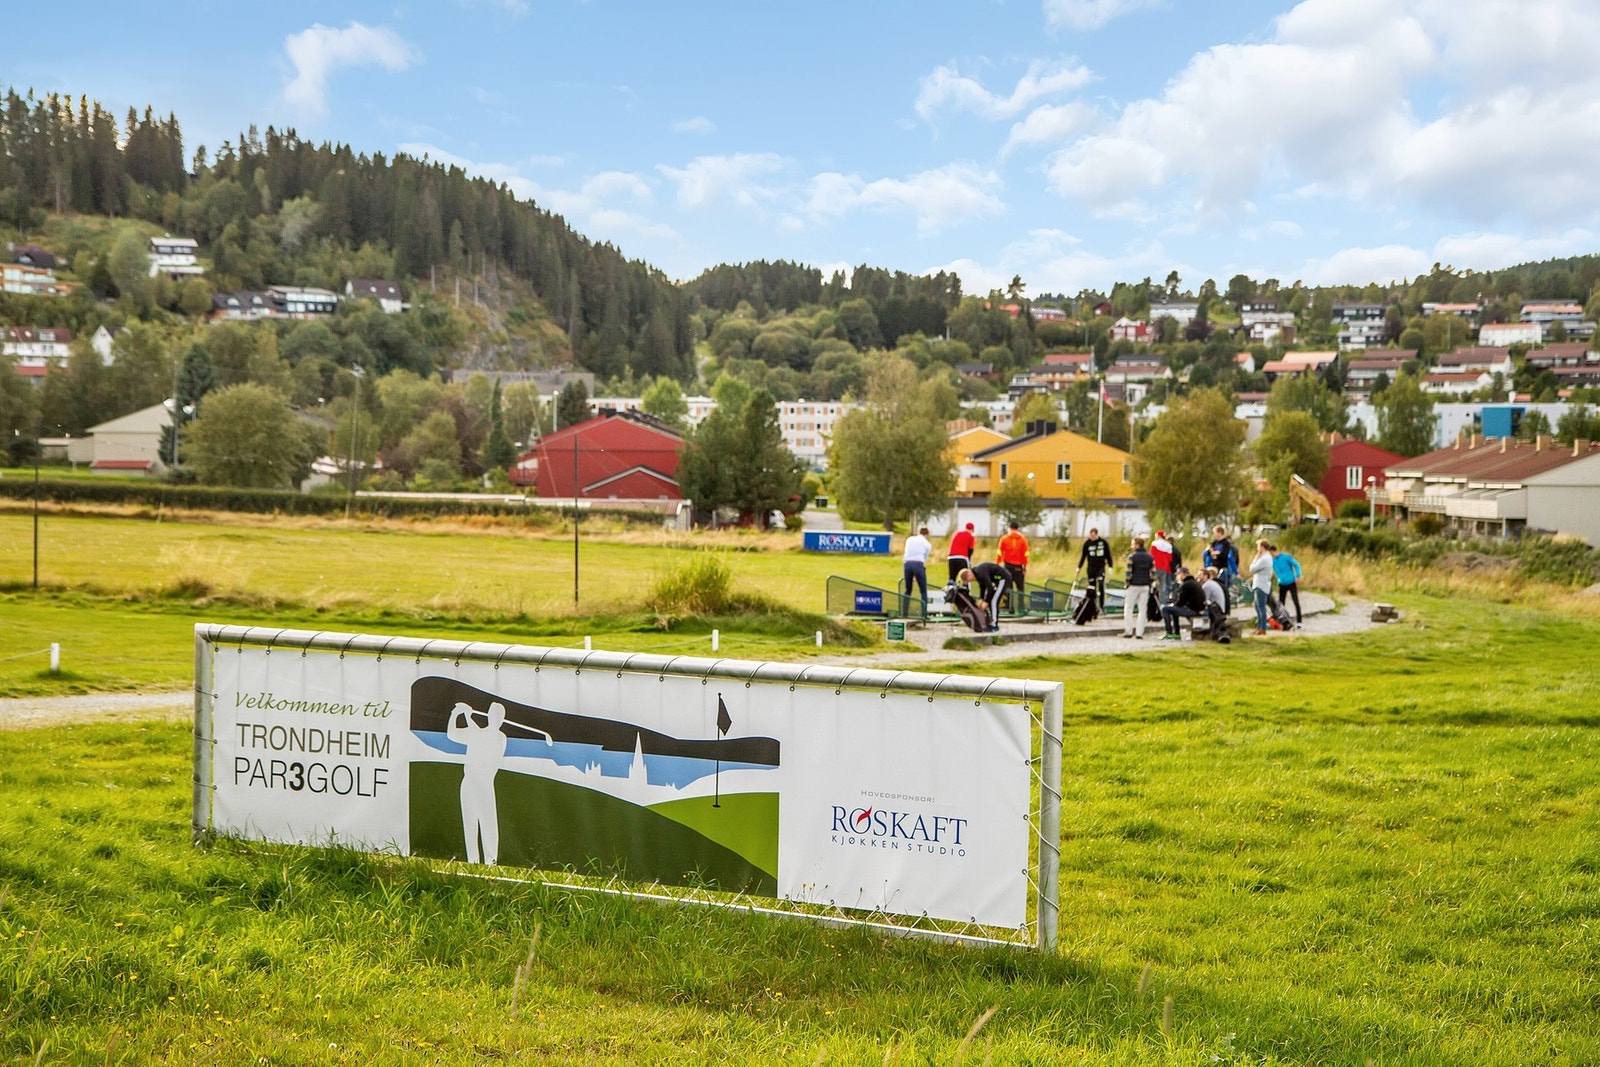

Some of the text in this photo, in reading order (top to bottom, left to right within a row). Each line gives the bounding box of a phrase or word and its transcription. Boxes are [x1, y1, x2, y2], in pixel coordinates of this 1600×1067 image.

[235, 692, 393, 718] Velkommen til
[236, 723, 391, 759] TRONDHEIM
[235, 757, 389, 798] PAR3GOLF
[831, 835, 966, 857] KJØKKEN STUDIO
